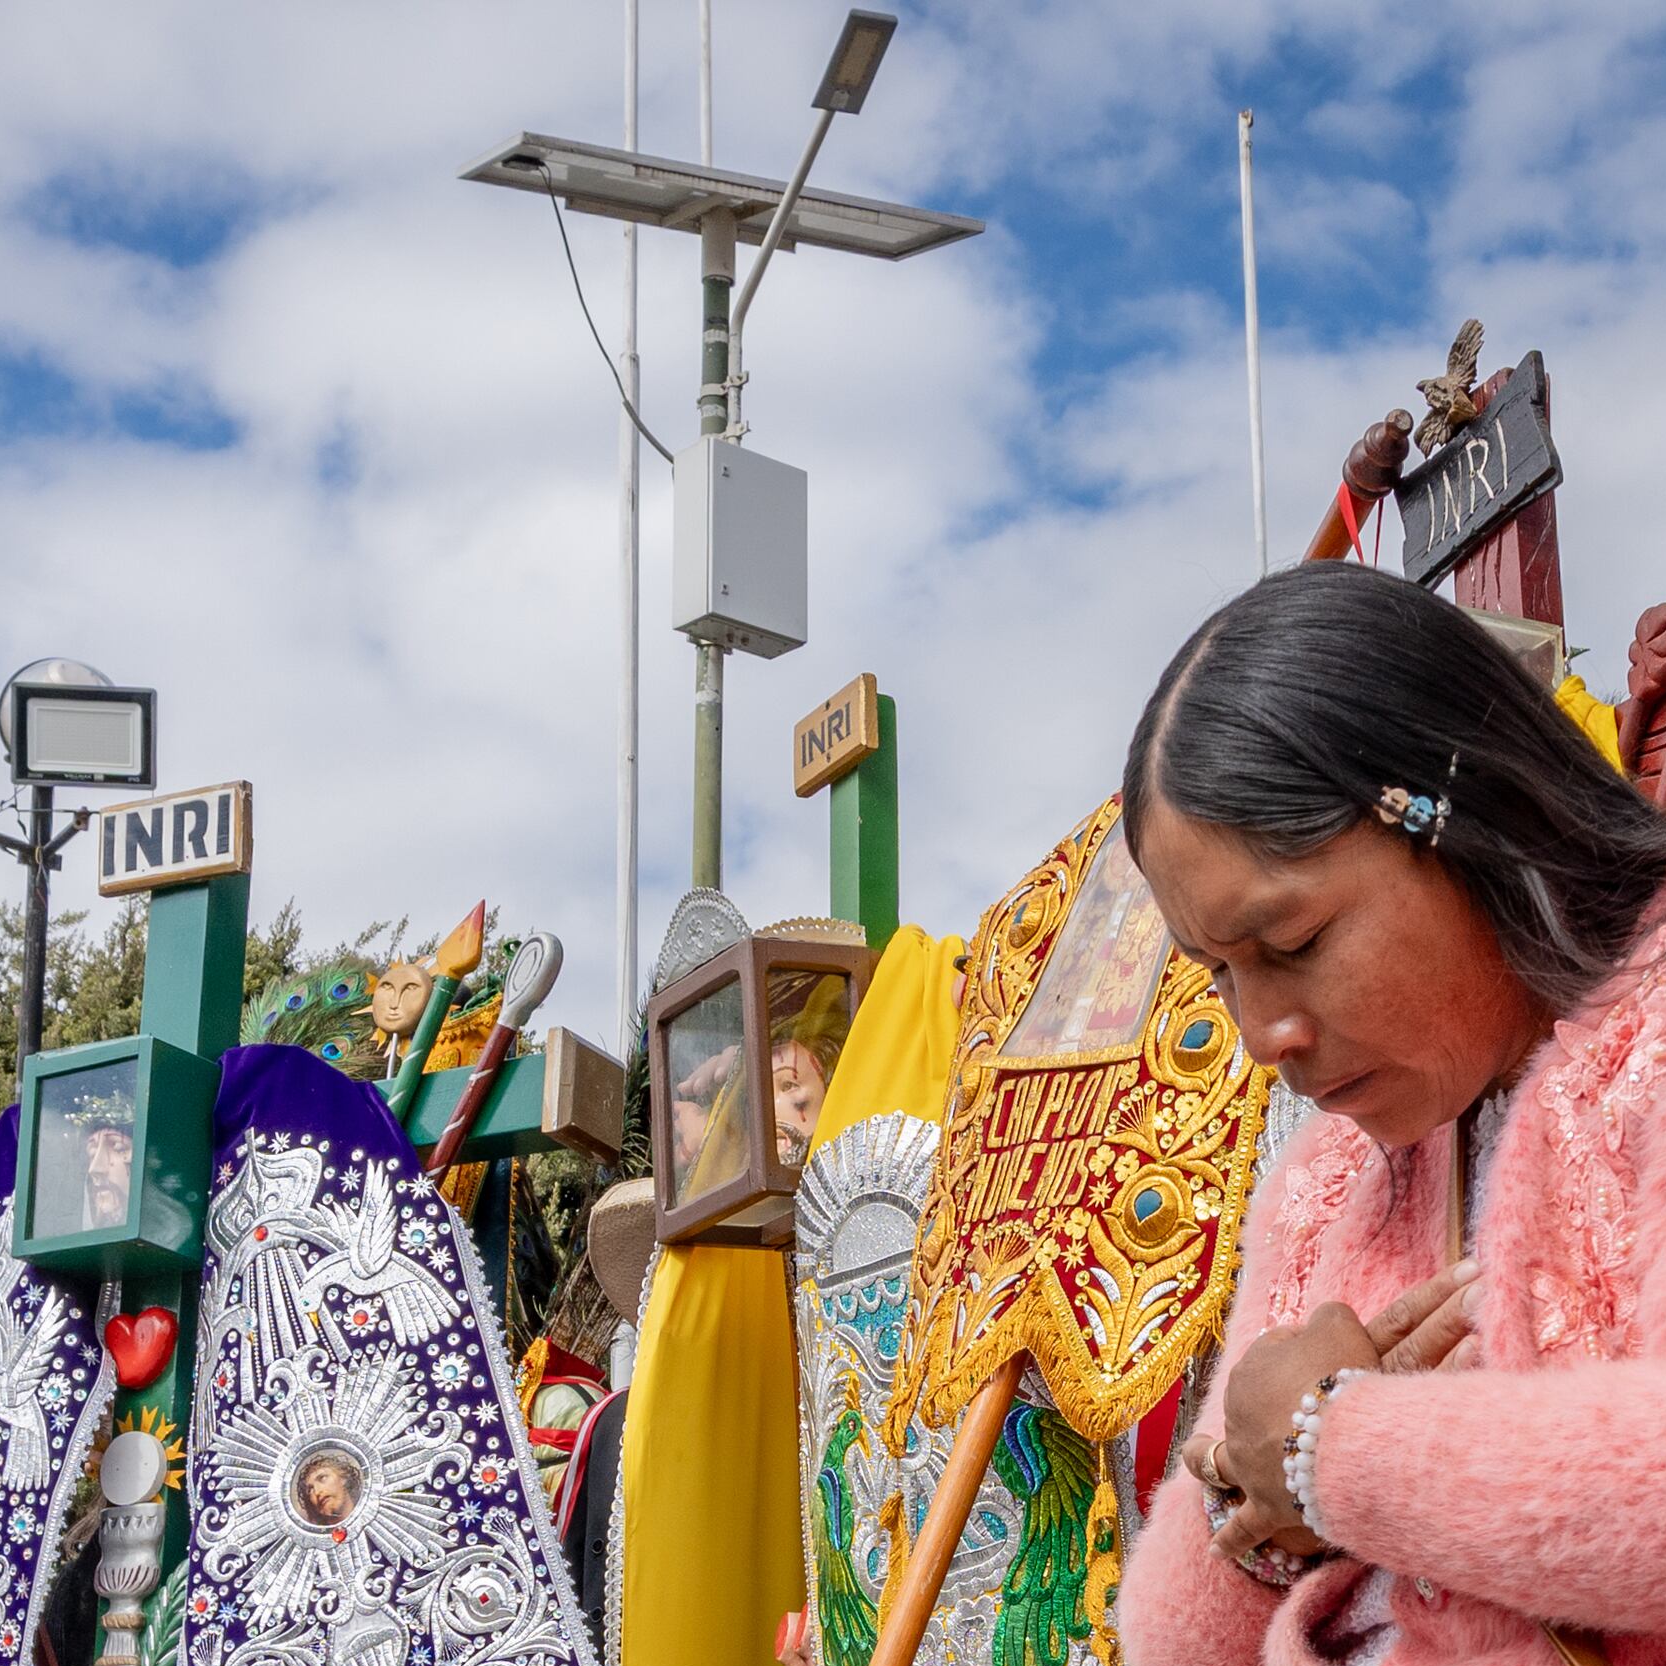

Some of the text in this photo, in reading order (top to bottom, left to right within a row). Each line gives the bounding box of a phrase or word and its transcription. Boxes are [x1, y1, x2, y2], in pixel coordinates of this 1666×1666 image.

[1427, 418, 1510, 553] INRI
[800, 702, 851, 769] INRI
[102, 793, 232, 877] INRI
[986, 1064, 1125, 1150] CAMPEON
[963, 1135, 1103, 1223] MORENOS
